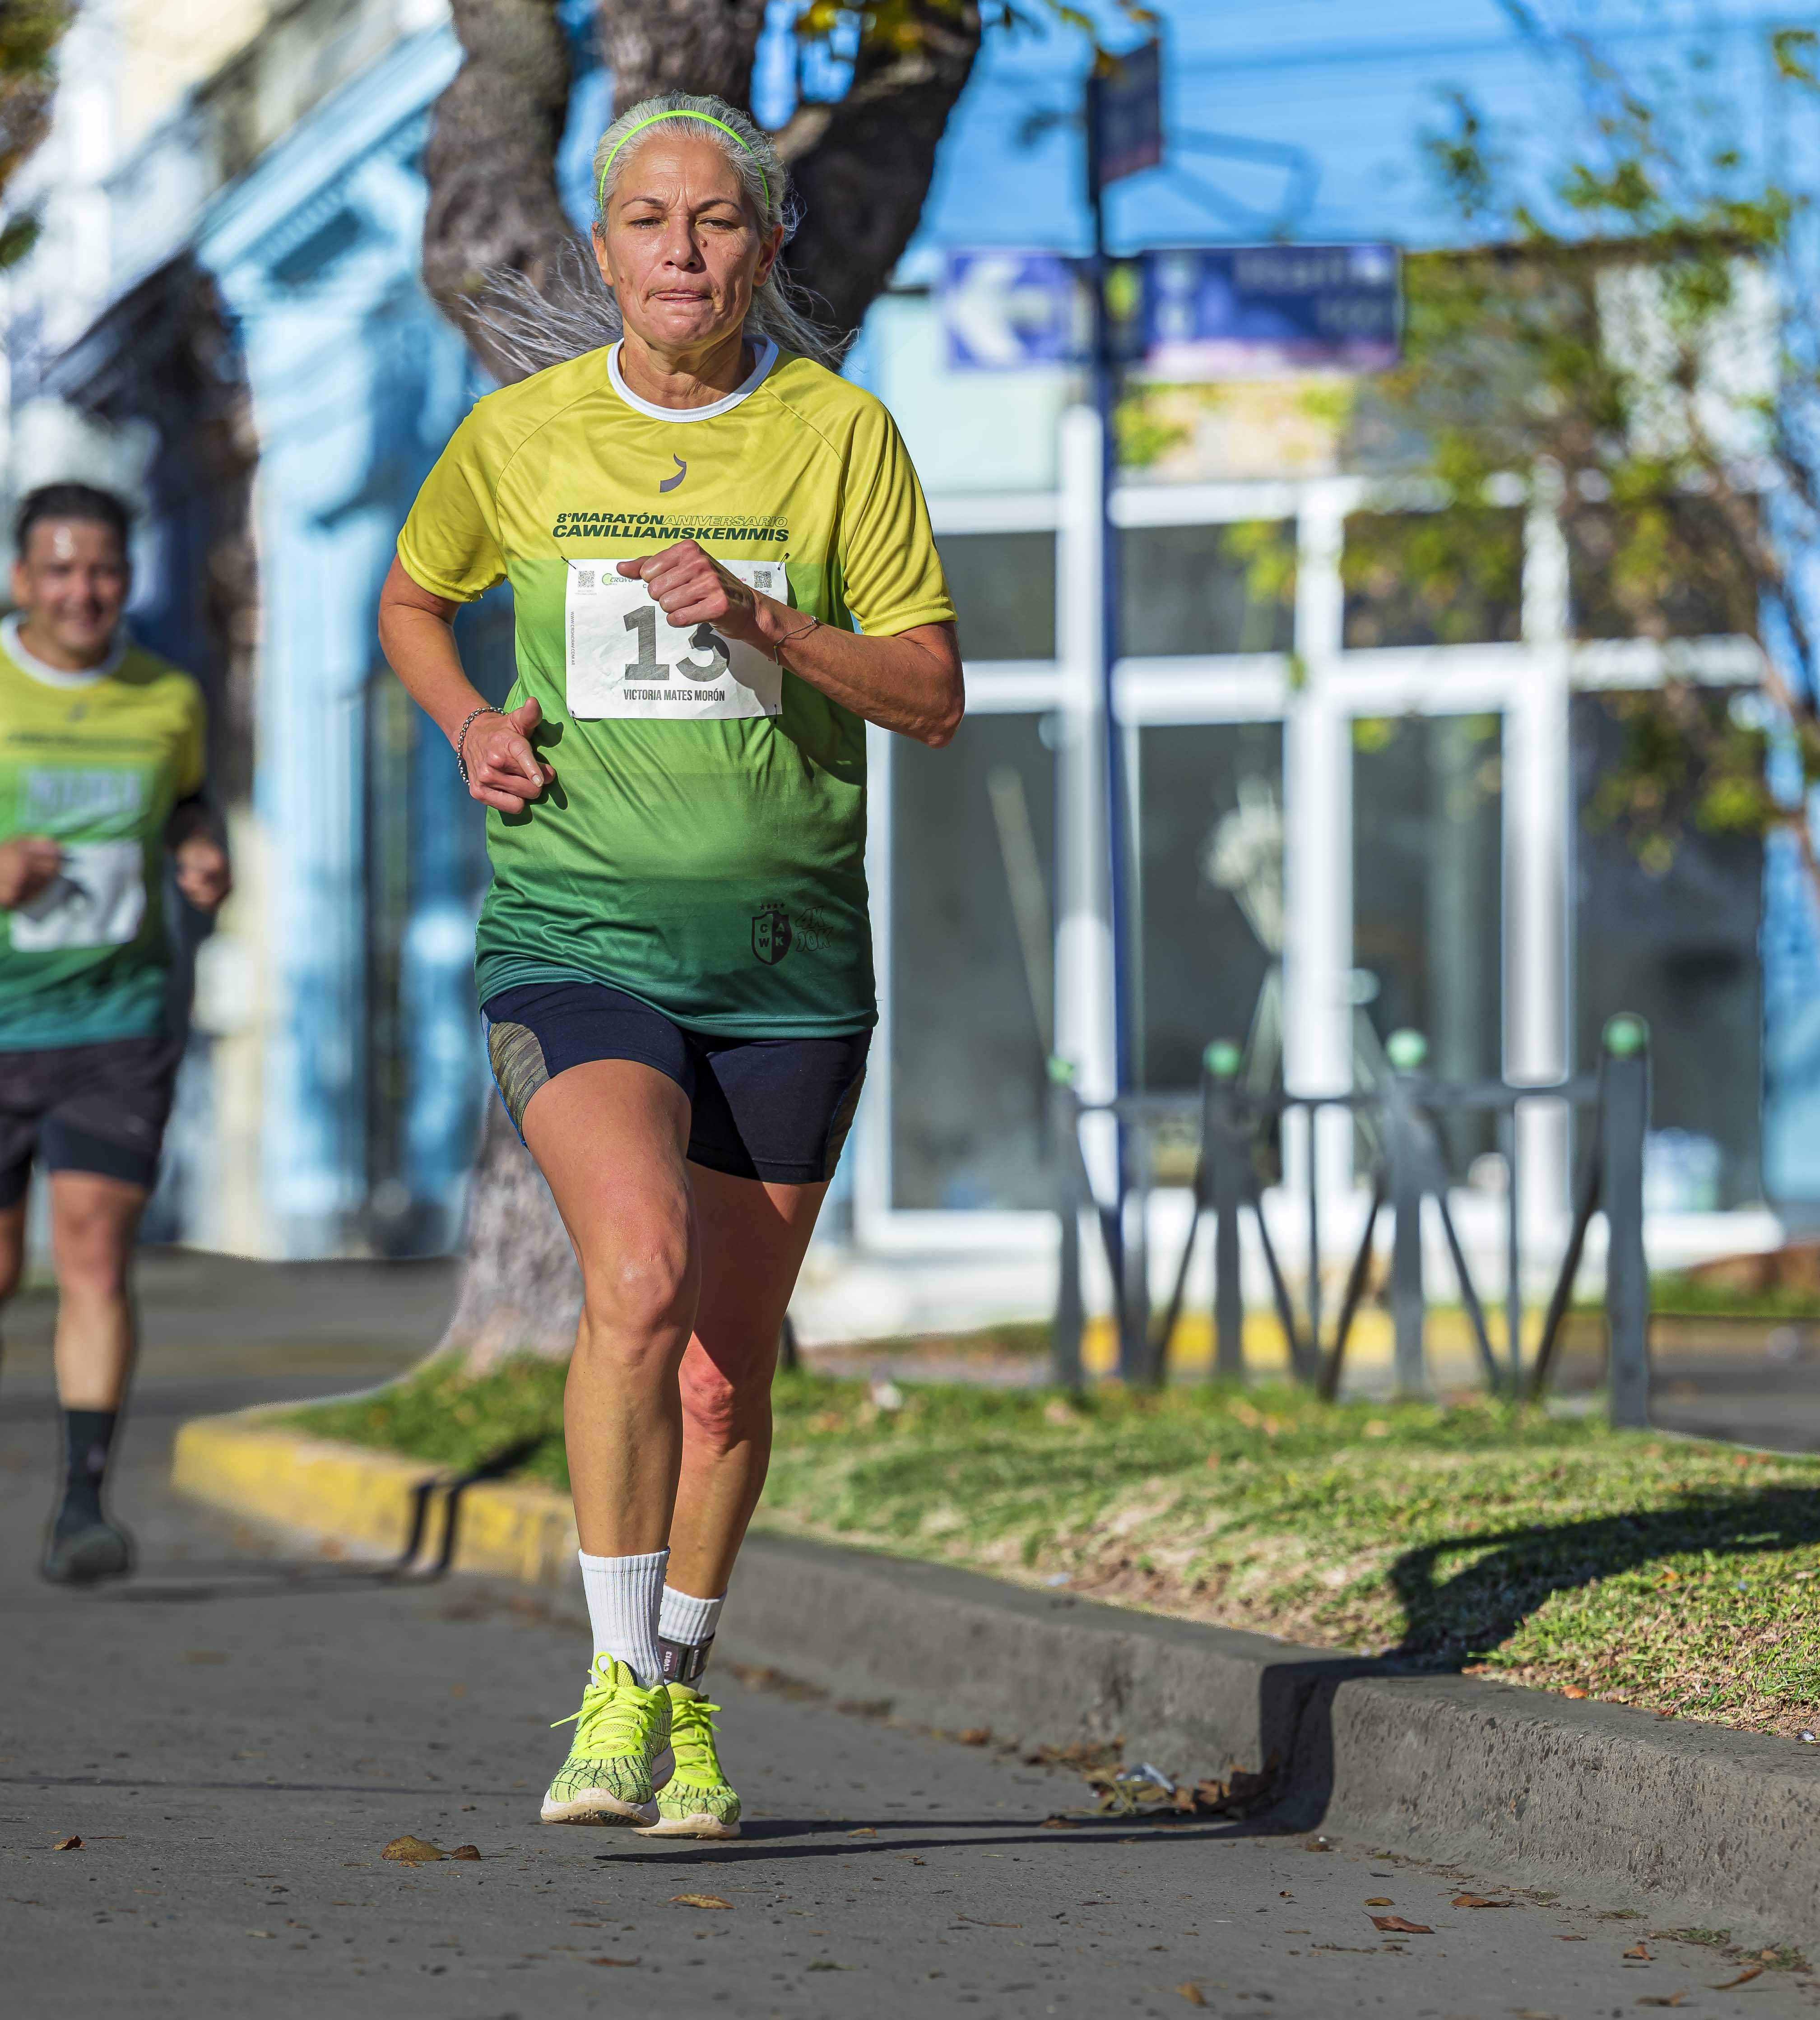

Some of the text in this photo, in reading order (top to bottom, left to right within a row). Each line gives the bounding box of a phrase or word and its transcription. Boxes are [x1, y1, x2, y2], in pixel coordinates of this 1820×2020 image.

[552, 524, 789, 542] CAWILLIAMSKEMMIS
[623, 606, 730, 682] 13
[624, 688, 725, 701] VICTORIA MATES MORÓN
[758, 936, 784, 947] W K
